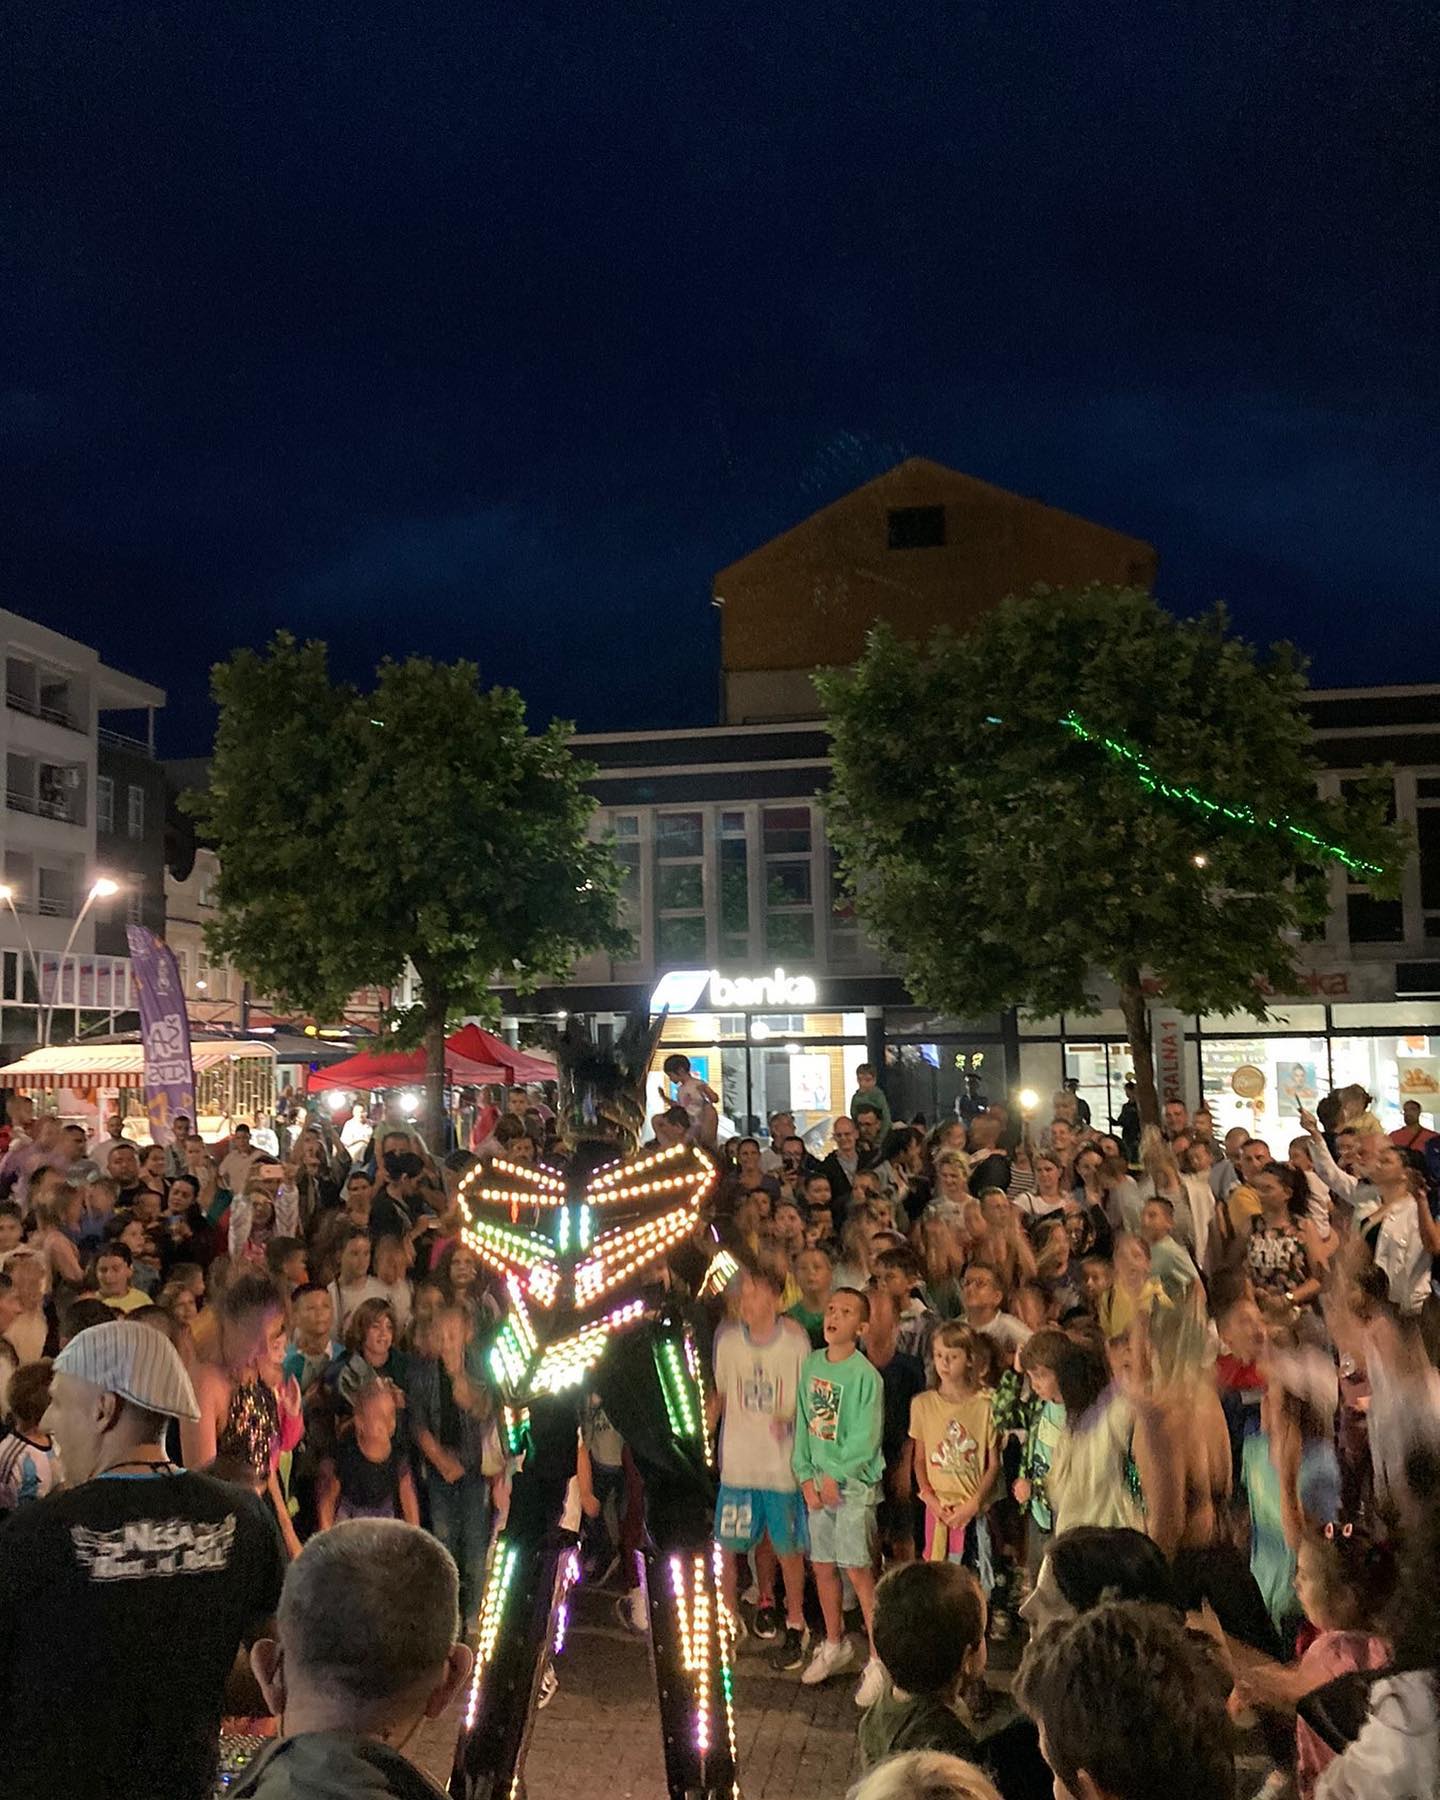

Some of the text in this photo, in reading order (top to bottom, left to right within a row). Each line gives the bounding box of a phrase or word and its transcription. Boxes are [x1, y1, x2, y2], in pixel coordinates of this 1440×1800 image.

[709, 967, 817, 1006] banka
[1161, 1034, 1179, 1100] RALNA
[720, 1503, 752, 1538] 22
